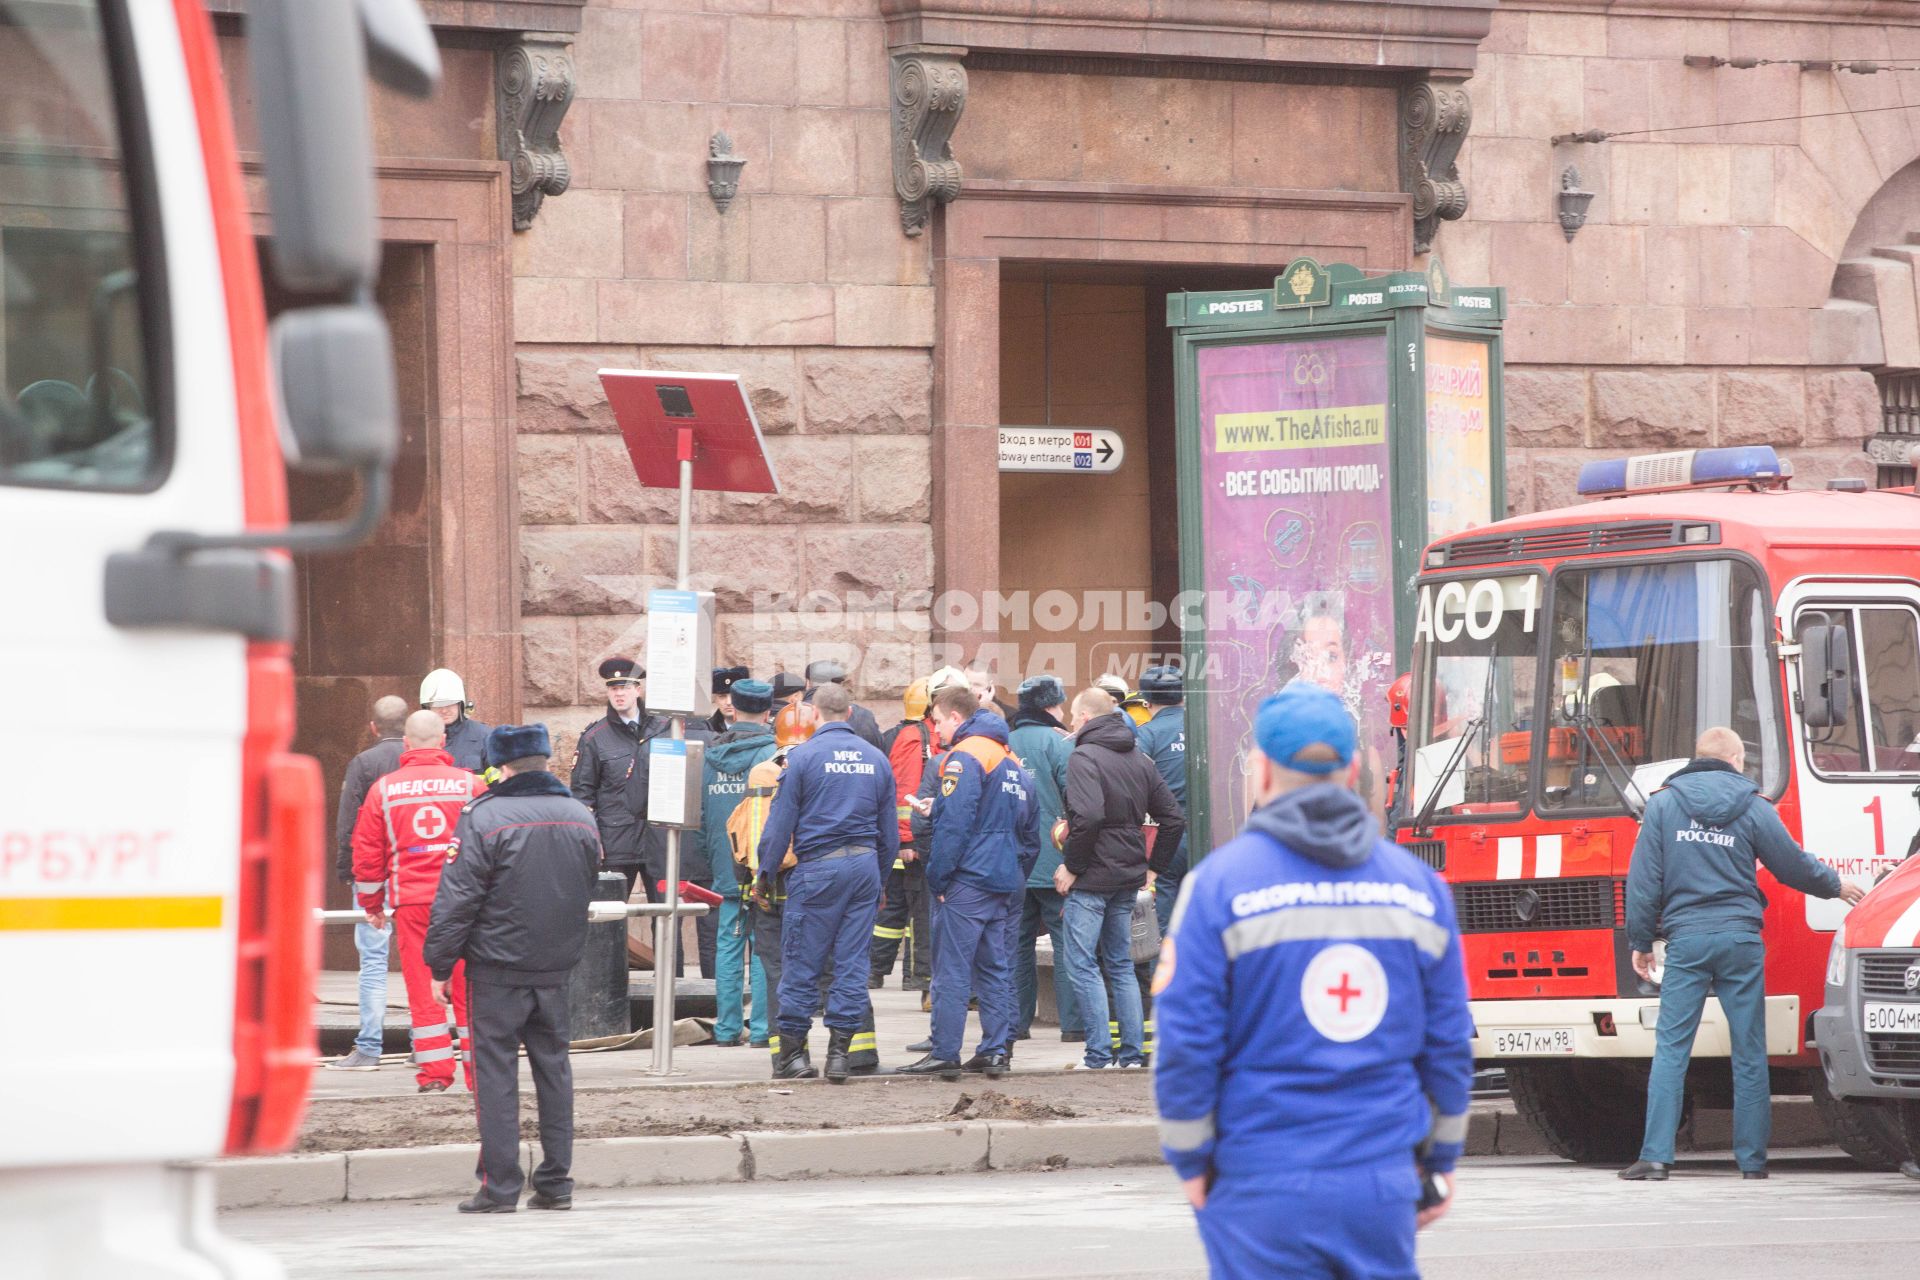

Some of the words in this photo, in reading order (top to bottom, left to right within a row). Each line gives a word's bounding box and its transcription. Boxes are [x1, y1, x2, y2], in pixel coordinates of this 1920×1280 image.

[1209, 299, 1264, 315] POSTER
[1348, 293, 1383, 306] POSTER
[1457, 295, 1492, 309] POSTER
[1224, 414, 1379, 444] www.TheAfisha.ru
[1000, 433, 1026, 446] Вход
[1029, 435, 1036, 446] в
[1038, 436, 1071, 450] метро
[1030, 453, 1072, 464] entrance
[1226, 470, 1258, 497] ВСЕ
[1260, 467, 1332, 495] СОБЫТИЯ
[1334, 463, 1380, 492] ГОРОДА
[1414, 578, 1504, 643] АСО
[1519, 574, 1538, 633] 1
[833, 750, 863, 761] МЧС
[825, 762, 875, 775] РОССИИ
[387, 779, 467, 797] МЕДСПАС
[1863, 796, 1885, 856] 1
[1676, 830, 1736, 848] РОССИИ
[1232, 882, 1333, 918] СКОРАЯ
